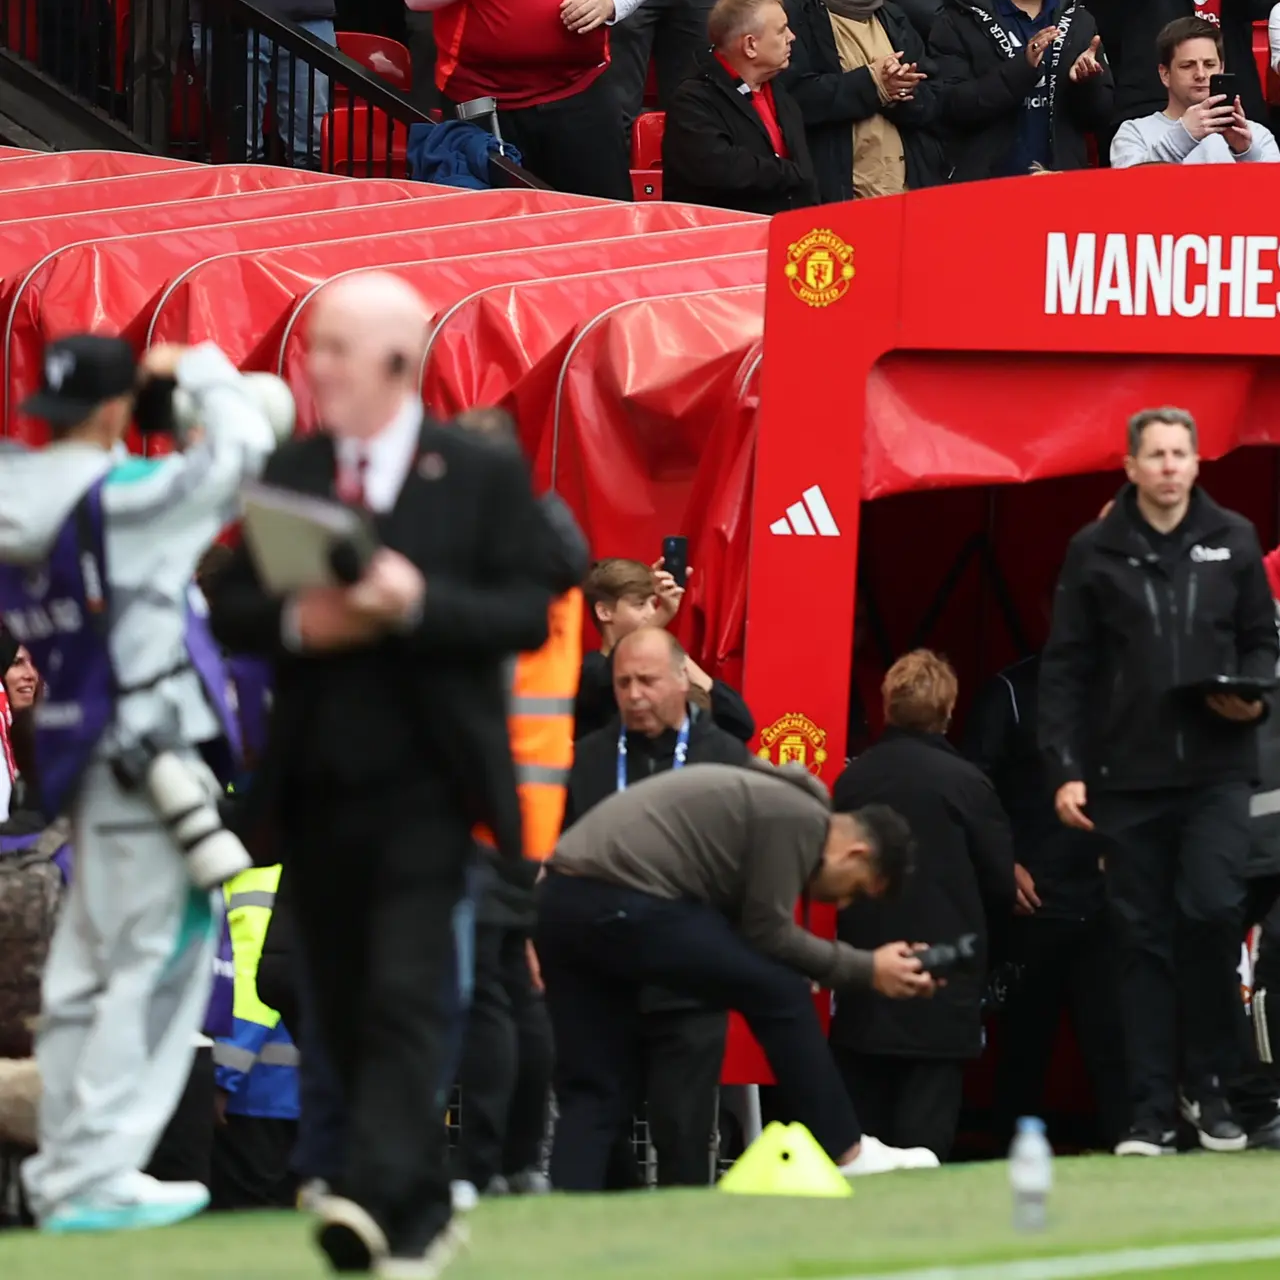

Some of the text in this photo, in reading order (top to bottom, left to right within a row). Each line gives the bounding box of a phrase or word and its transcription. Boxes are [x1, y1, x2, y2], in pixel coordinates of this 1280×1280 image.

[792, 232, 850, 262] MANCHESTER
[798, 287, 840, 304] UNITED
[765, 718, 822, 746] MANCHESTER
